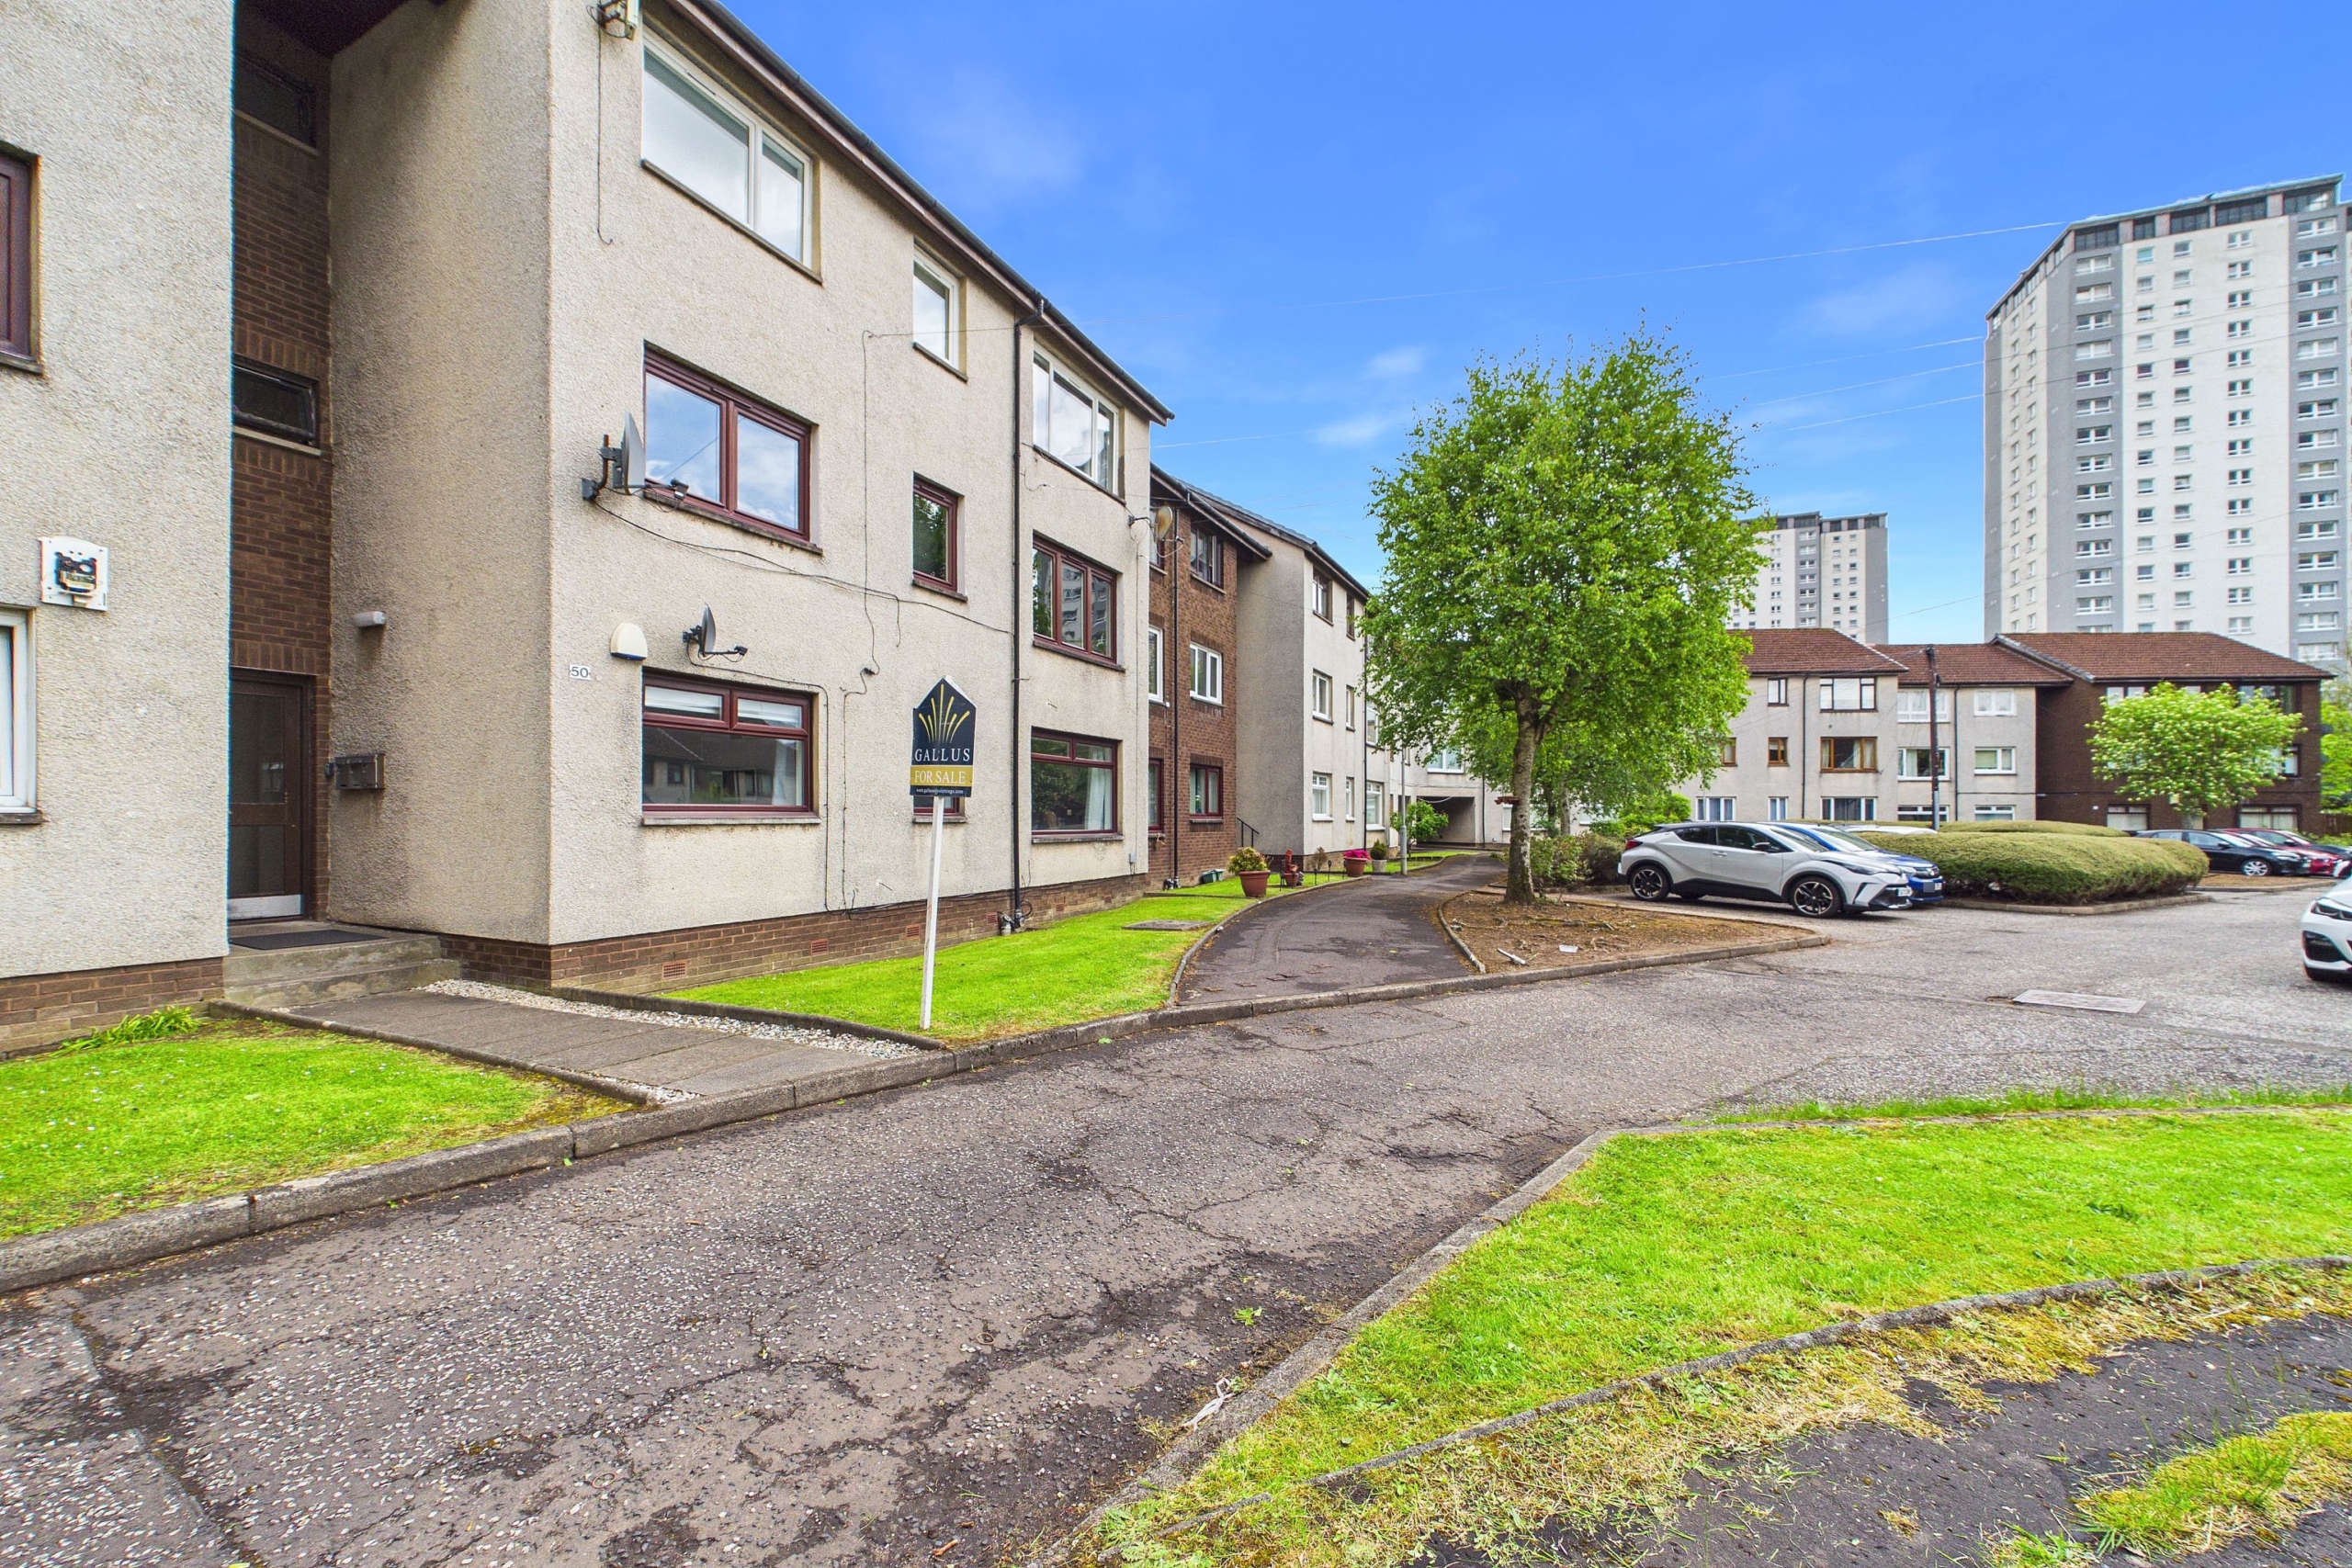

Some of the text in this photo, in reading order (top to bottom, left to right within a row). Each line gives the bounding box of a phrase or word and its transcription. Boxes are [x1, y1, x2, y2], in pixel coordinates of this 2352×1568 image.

[571, 666, 589, 679] 50
[914, 748, 970, 761] GALLUS
[914, 770, 967, 784] FOR SALE
